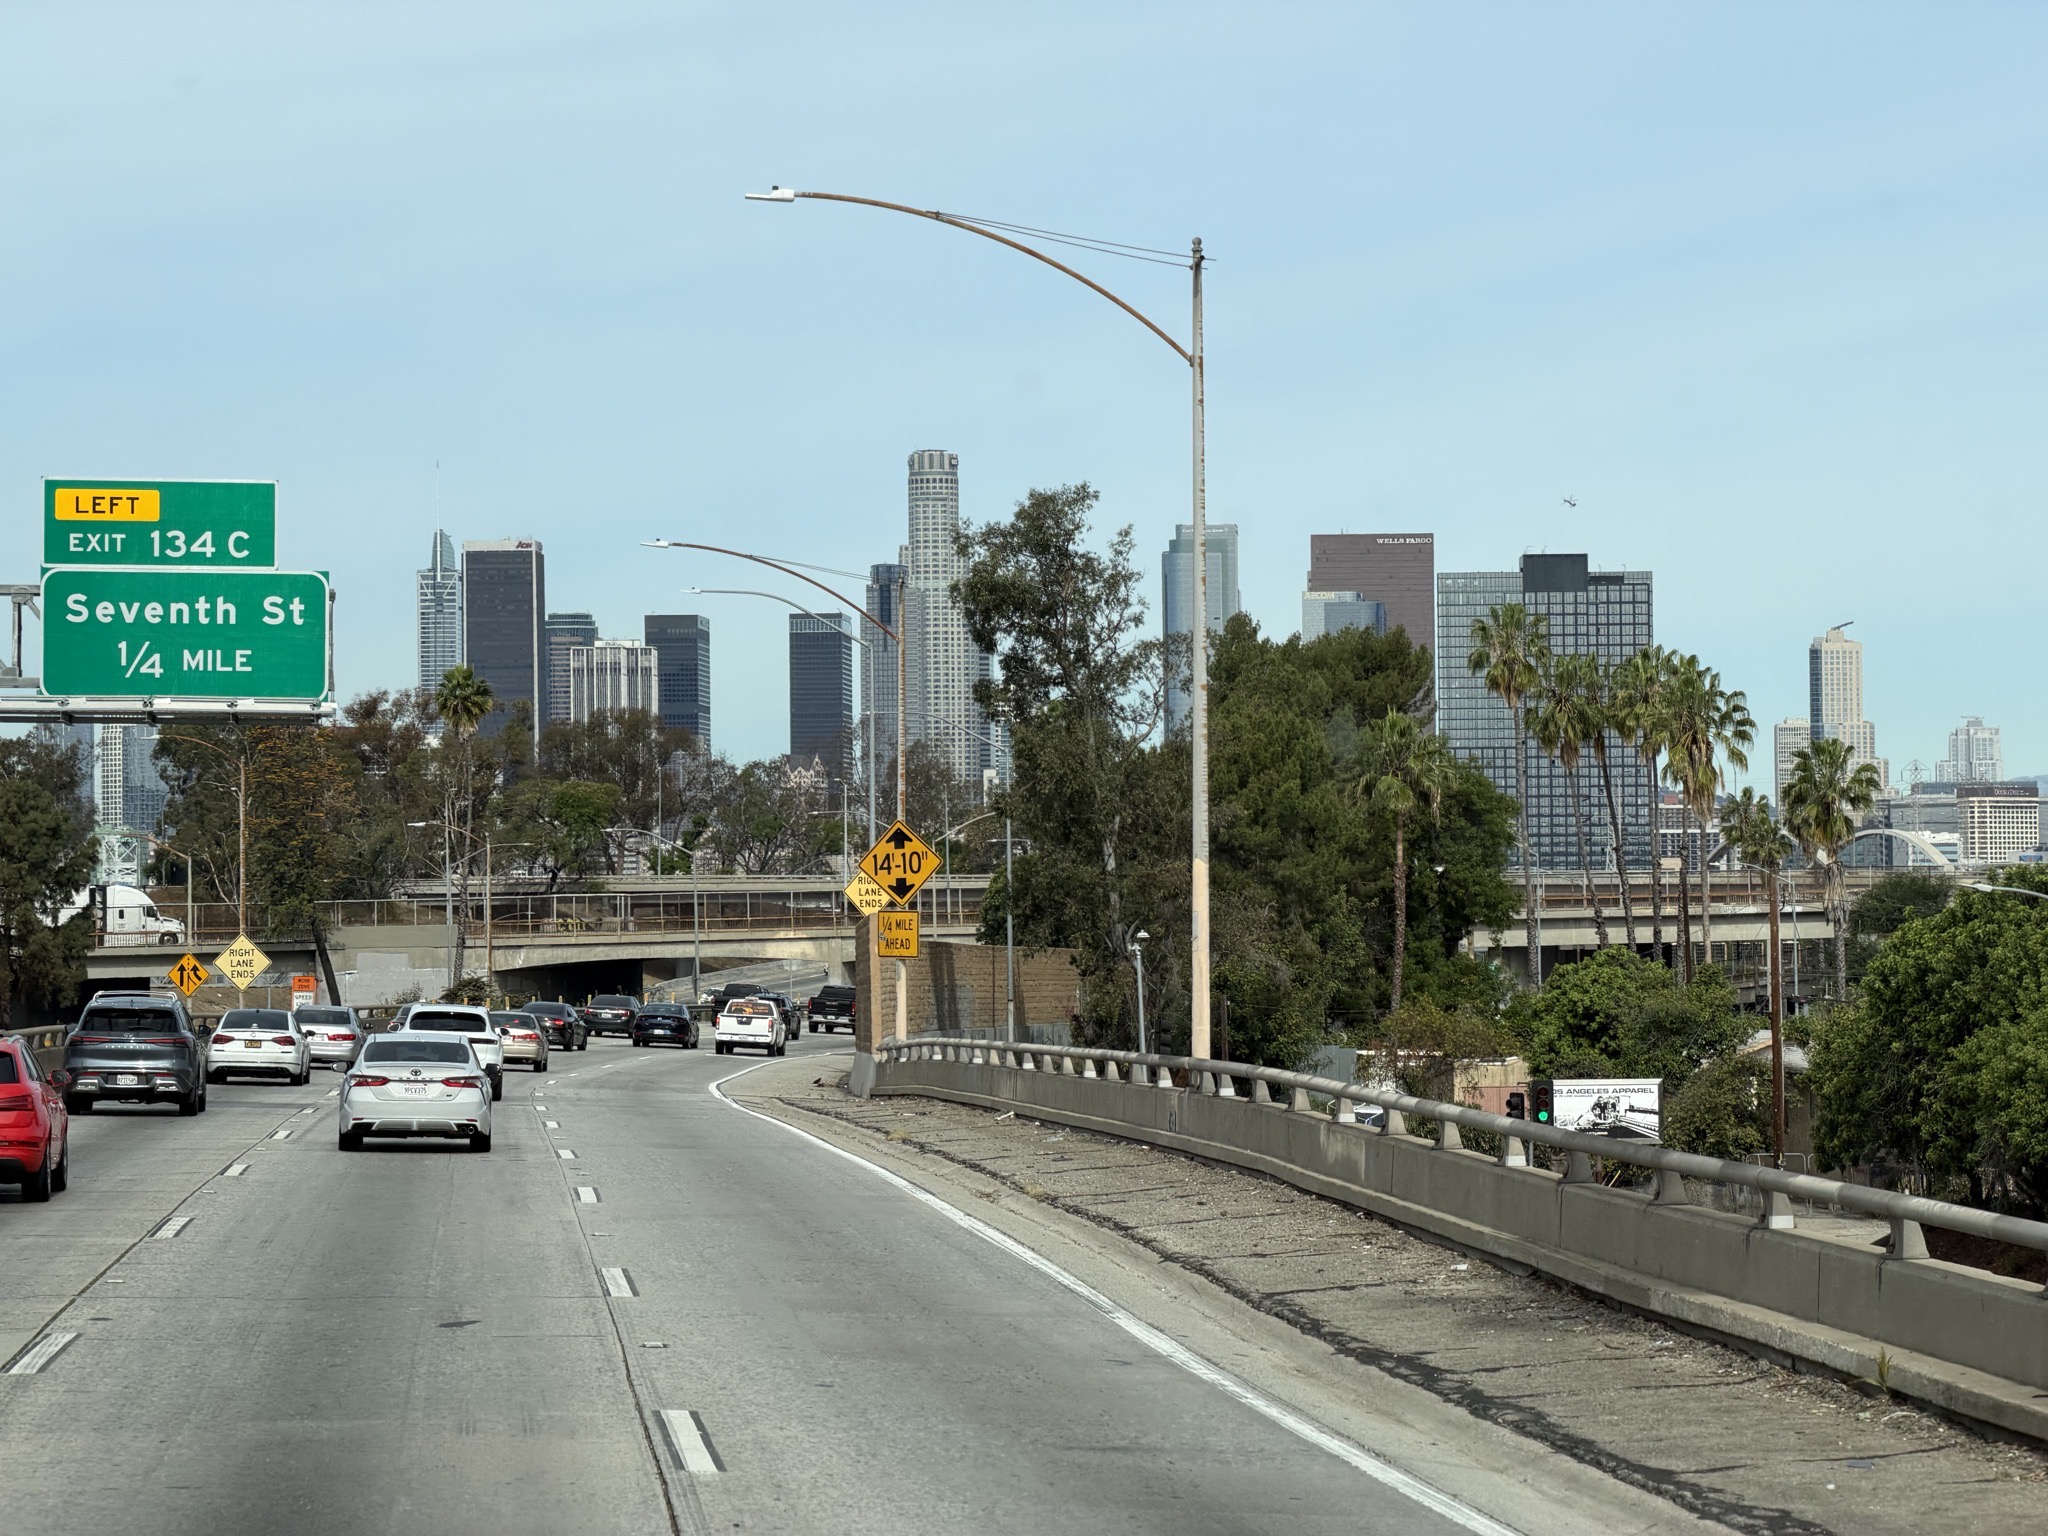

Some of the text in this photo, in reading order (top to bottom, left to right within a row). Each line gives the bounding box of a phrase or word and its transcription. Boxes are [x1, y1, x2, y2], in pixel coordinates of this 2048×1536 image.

[75, 496, 140, 515] LEFT
[69, 530, 250, 558] EXIT 134 C
[1304, 592, 1335, 600] AECOM
[65, 593, 305, 626] Seventh St
[182, 650, 252, 672] MILE
[858, 888, 883, 896] LANE
[860, 900, 883, 908] ENDS
[895, 919, 913, 931] MILE
[884, 938, 910, 950] AHEAD
[229, 948, 255, 957] RIGHT
[230, 958, 255, 968] LANE
[230, 970, 255, 979] ENDS
